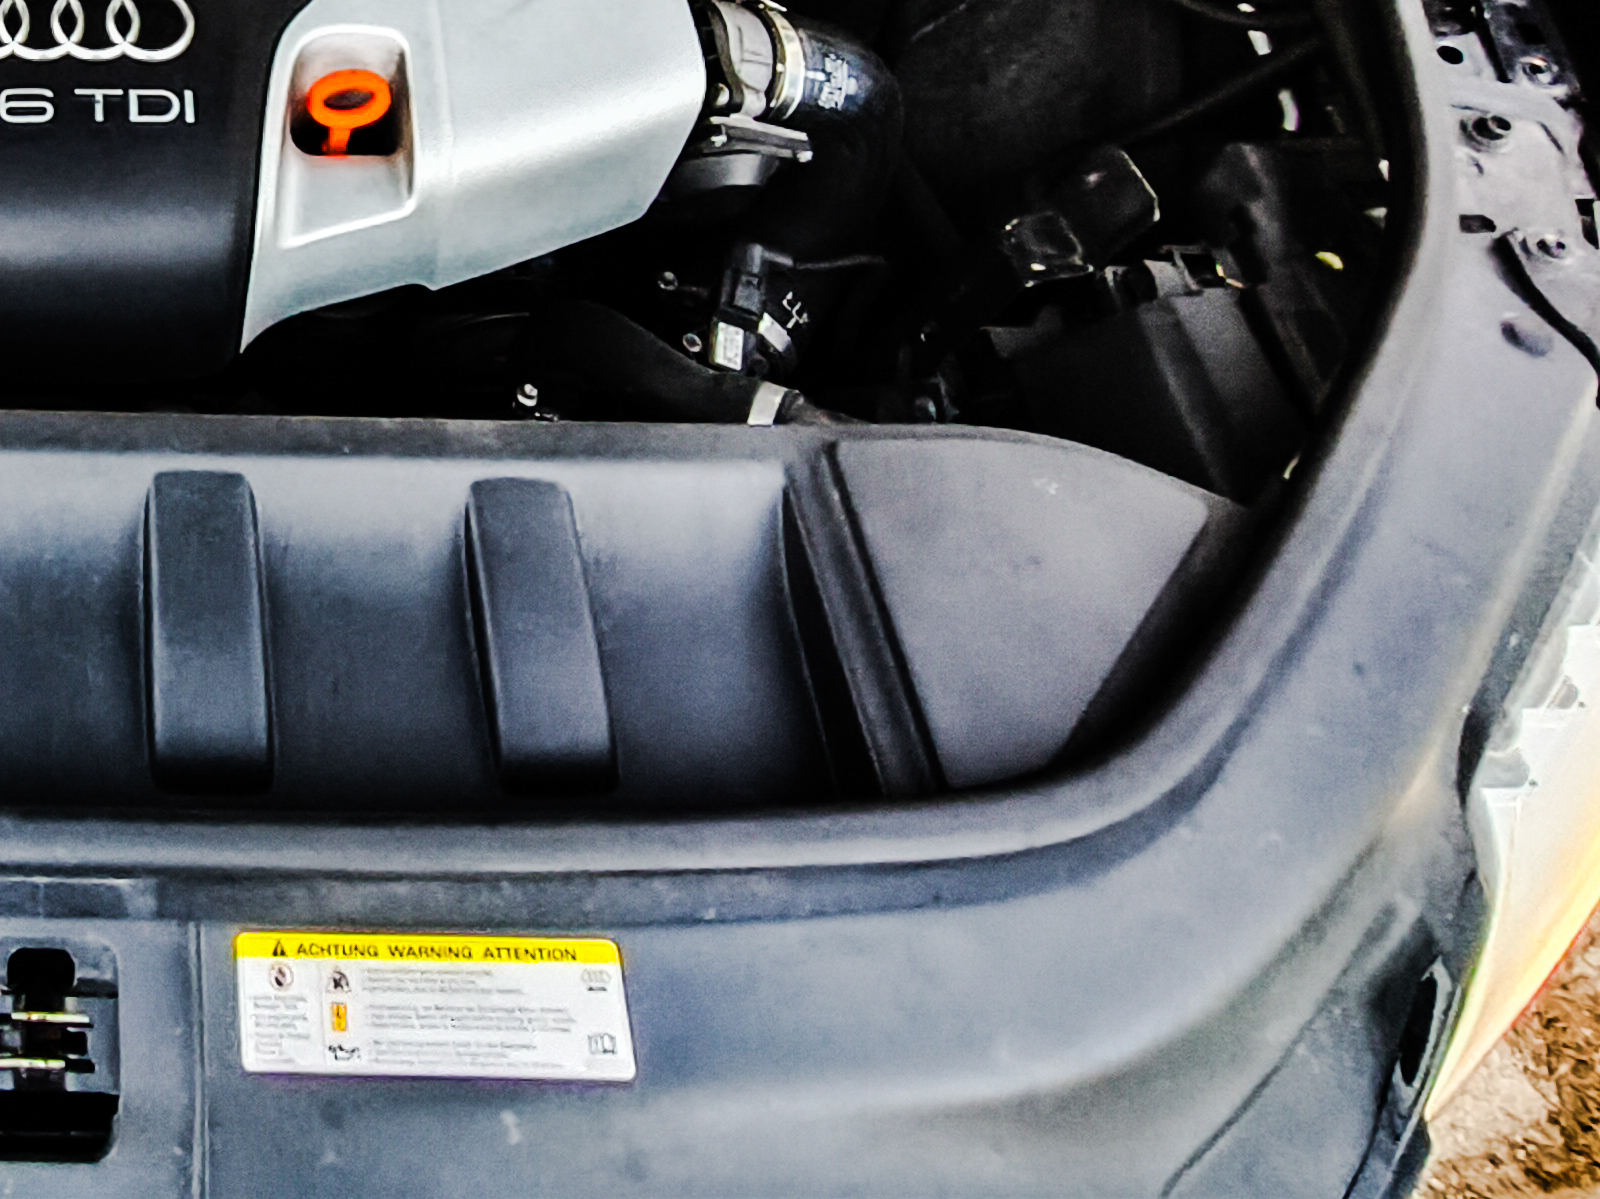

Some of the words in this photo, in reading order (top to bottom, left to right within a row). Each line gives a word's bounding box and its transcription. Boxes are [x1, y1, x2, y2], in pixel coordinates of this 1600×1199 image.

[73, 87, 196, 124] TDI
[296, 942, 379, 958] ACHTUNG
[387, 943, 474, 960] WARNING
[482, 945, 578, 961] ATTENTION
